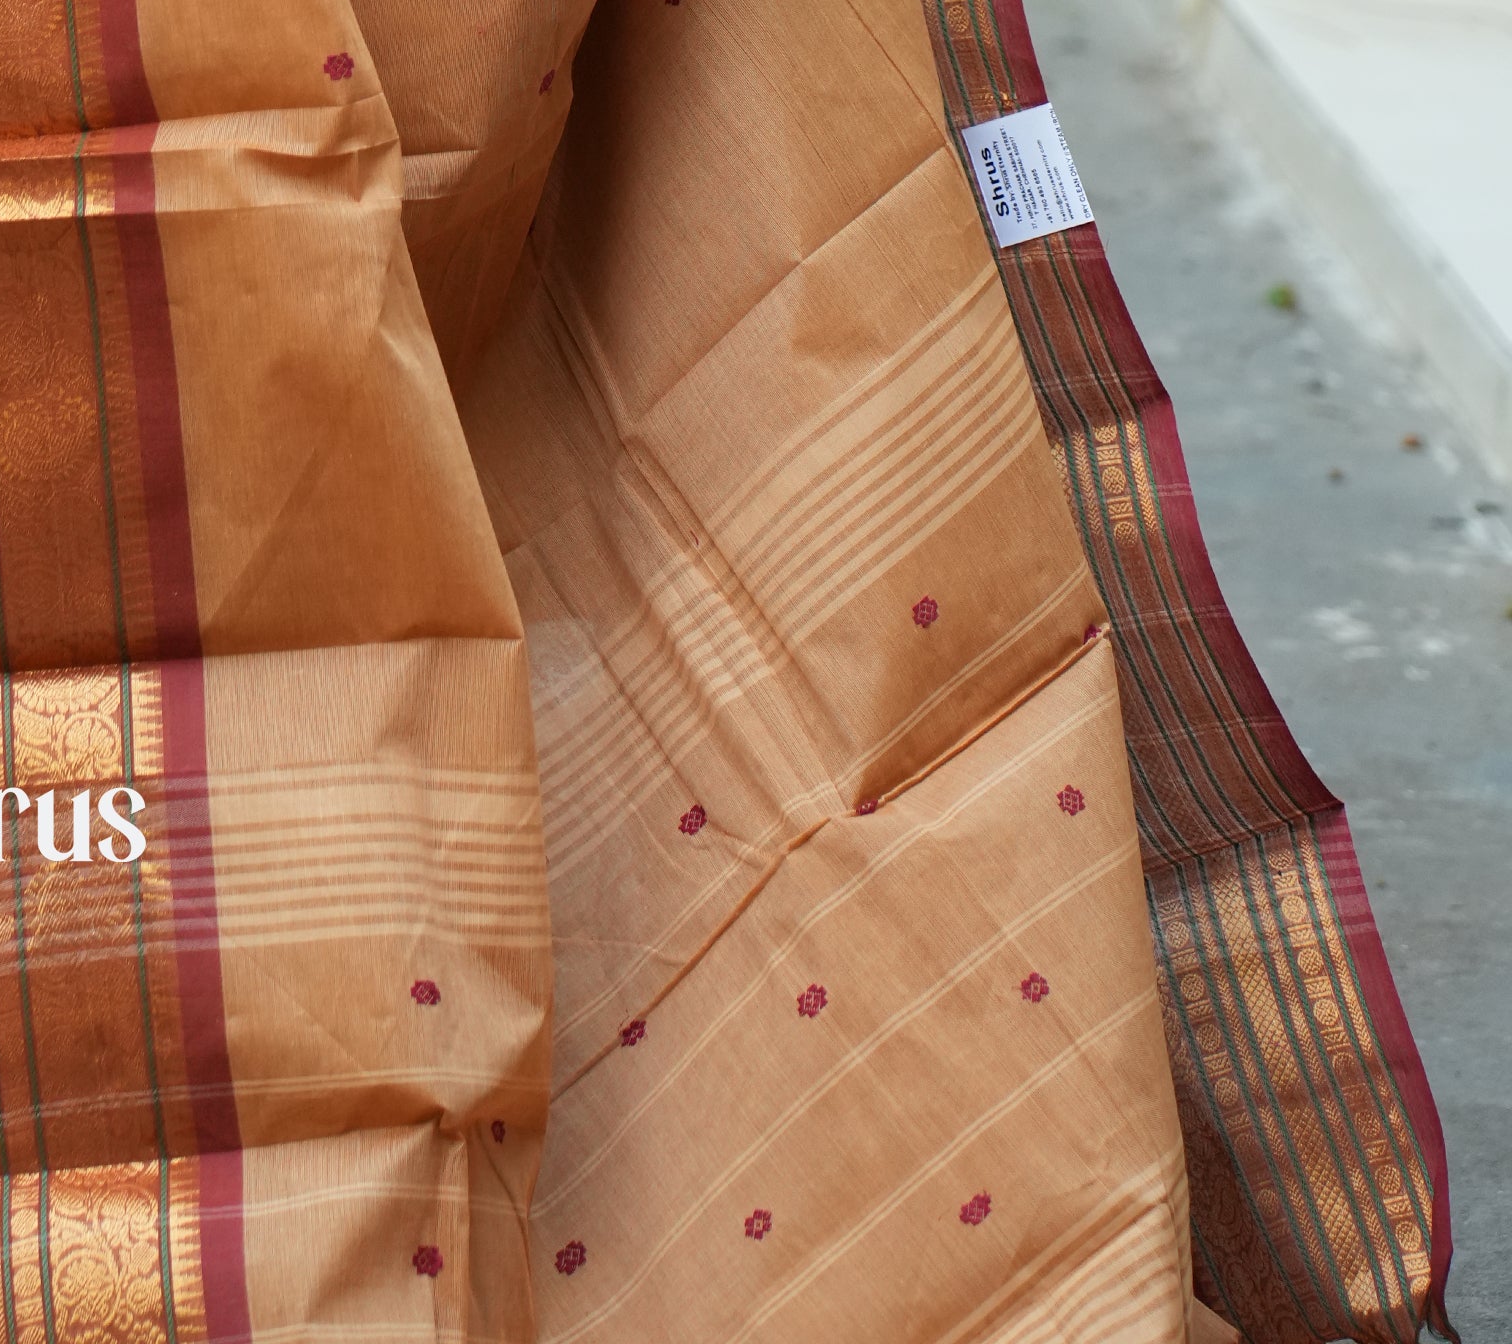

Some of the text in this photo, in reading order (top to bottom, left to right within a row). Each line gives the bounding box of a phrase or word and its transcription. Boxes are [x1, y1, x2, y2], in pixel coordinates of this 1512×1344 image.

[1055, 127, 1067, 150] STEAM
[992, 141, 1005, 169] Eternity
[1065, 156, 1076, 177] ONLY
[981, 147, 1009, 217] Shrus
[1000, 169, 1012, 190] Shrus
[1073, 177, 1085, 202] CLEAN
[1011, 202, 1023, 223] Trade
[1081, 203, 1091, 218] DRY
